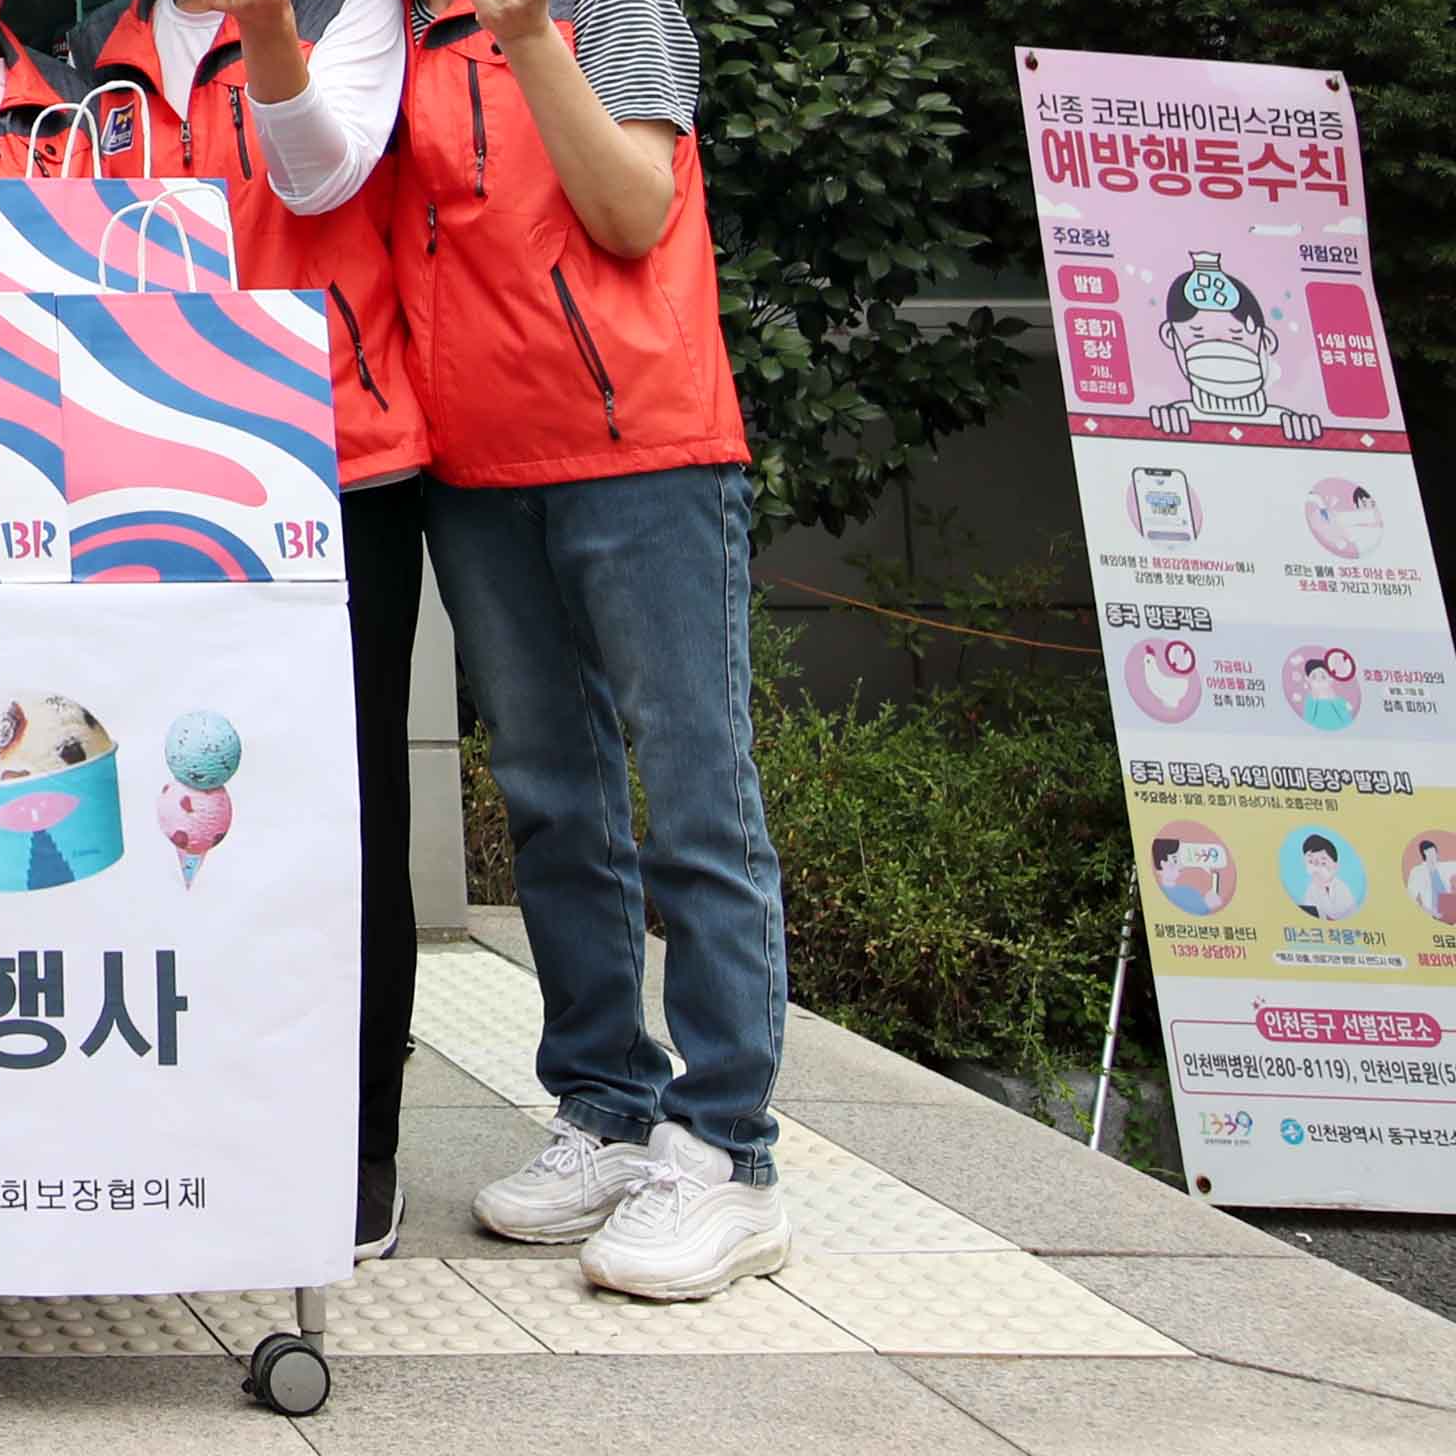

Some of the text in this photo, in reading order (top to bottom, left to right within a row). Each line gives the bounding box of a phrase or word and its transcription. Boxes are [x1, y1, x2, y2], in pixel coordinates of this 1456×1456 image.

[1037, 93, 1344, 141] 신종 코로나바이러스감염증
[1041, 128, 1349, 206] 예방행동수칙
[1053, 226, 1110, 247] 주요증상
[1299, 244, 1359, 264] 위험요인
[1317, 333, 1374, 350] 14일 이내
[1, 520, 57, 560] BR
[274, 520, 330, 560] BR
[1106, 603, 1212, 632] 중국 방문객은
[1130, 760, 1164, 785] 중국
[1168, 761, 1205, 786] 방문
[1230, 764, 1270, 790] 14일
[1271, 766, 1307, 791] 이내
[1354, 770, 1391, 794] 발생
[1394, 771, 1414, 796] 시
[1284, 927, 1324, 943] 마스크
[1170, 943, 1247, 959] 1339 상담하기
[1263, 1010, 1435, 1042] 인천동구 선별진료소
[1307, 1123, 1383, 1144] 인천광역시
